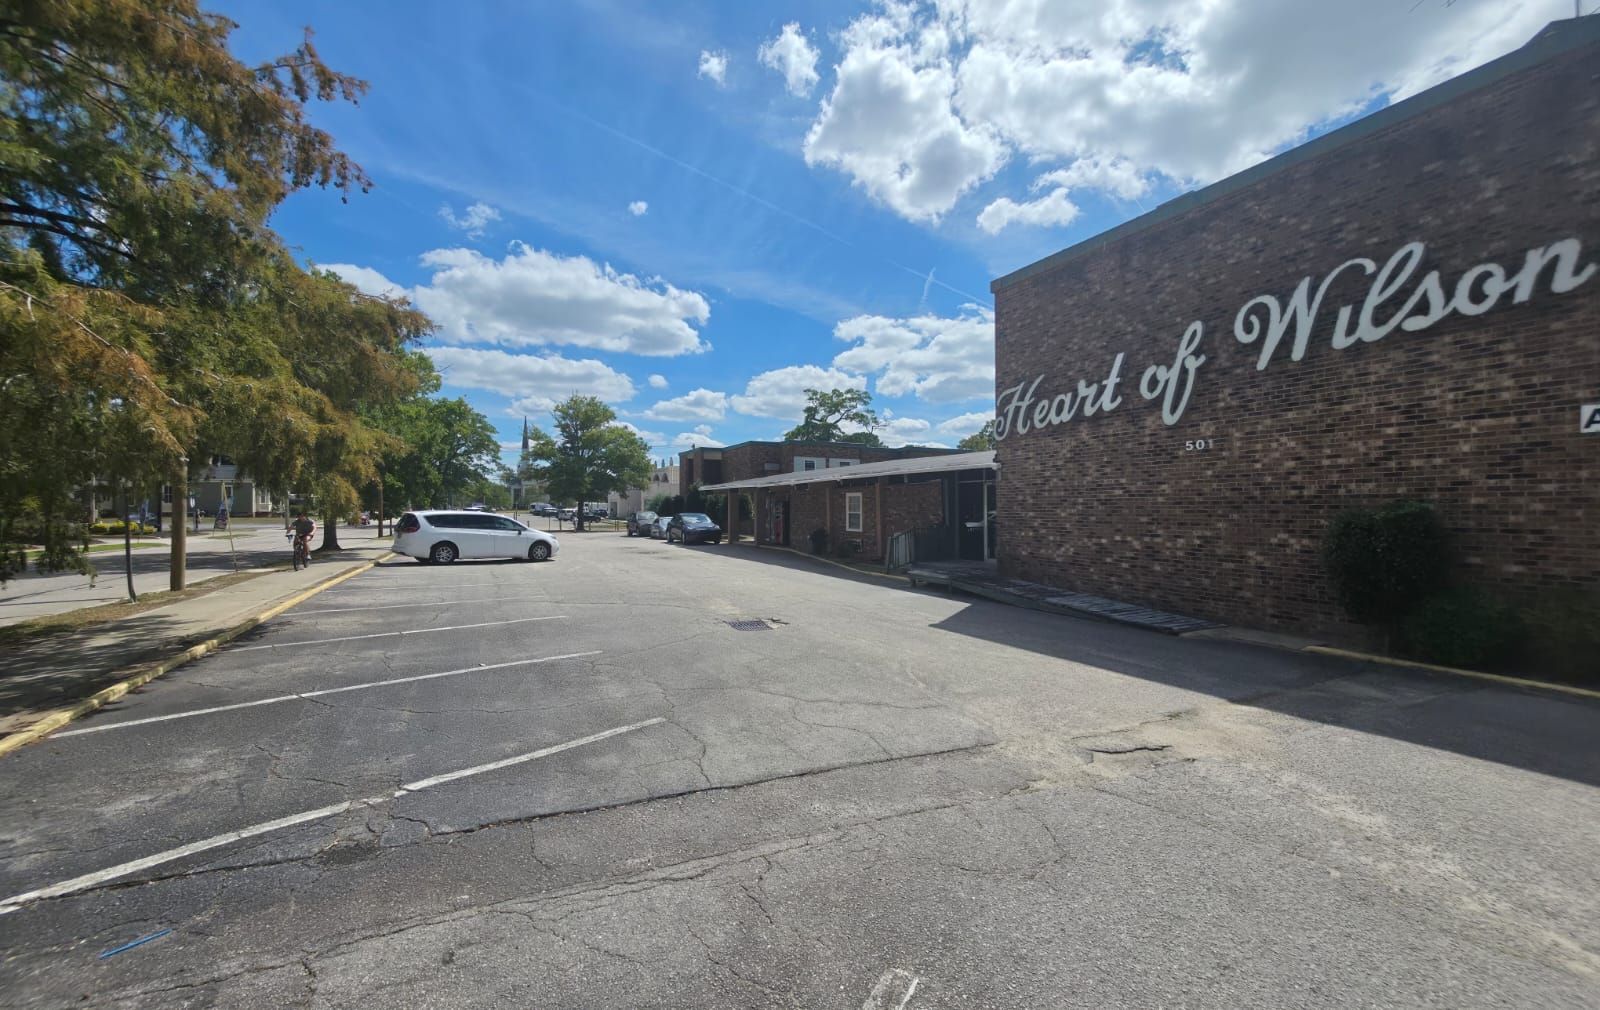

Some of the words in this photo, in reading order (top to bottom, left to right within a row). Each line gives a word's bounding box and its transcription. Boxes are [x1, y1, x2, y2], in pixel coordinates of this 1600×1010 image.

[994, 352, 1125, 441] Heart
[1140, 320, 1206, 425] of
[1234, 238, 1599, 371] Wilson
[1185, 439, 1214, 451] 501
